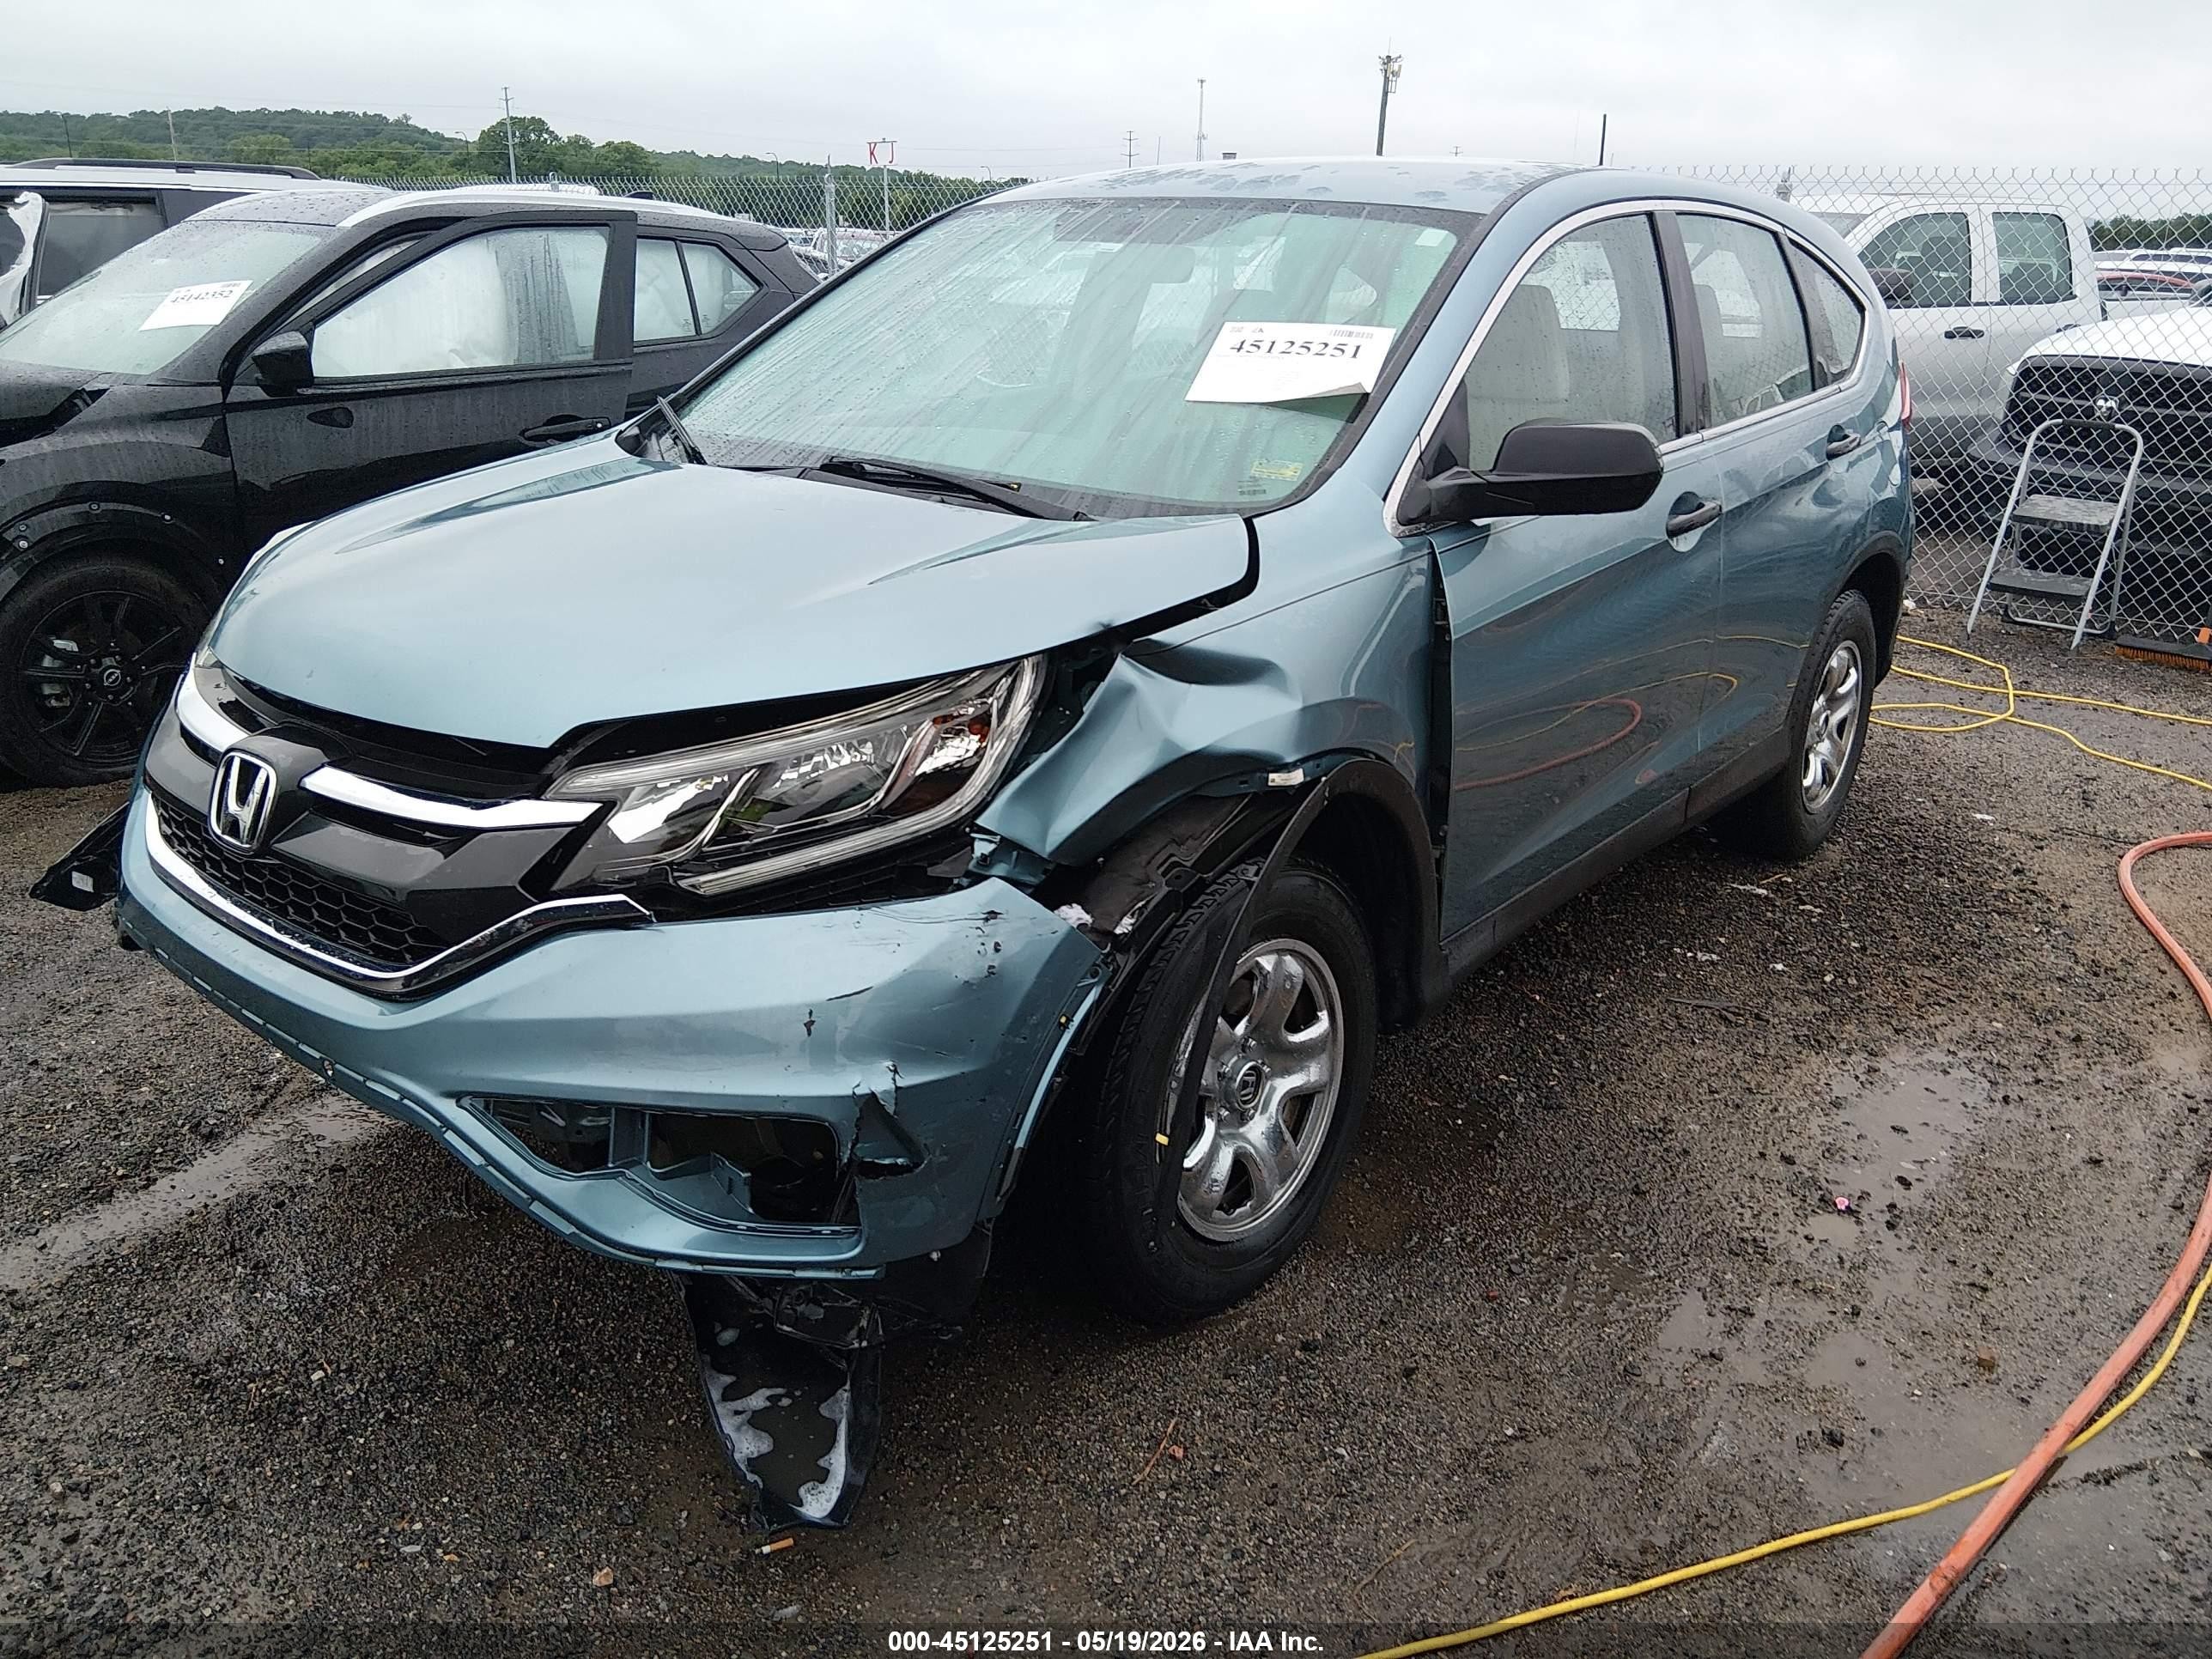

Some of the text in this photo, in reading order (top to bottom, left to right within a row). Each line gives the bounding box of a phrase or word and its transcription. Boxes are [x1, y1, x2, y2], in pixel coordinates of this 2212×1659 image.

[868, 142, 895, 165] K J
[1229, 338, 1363, 359] 45125251
